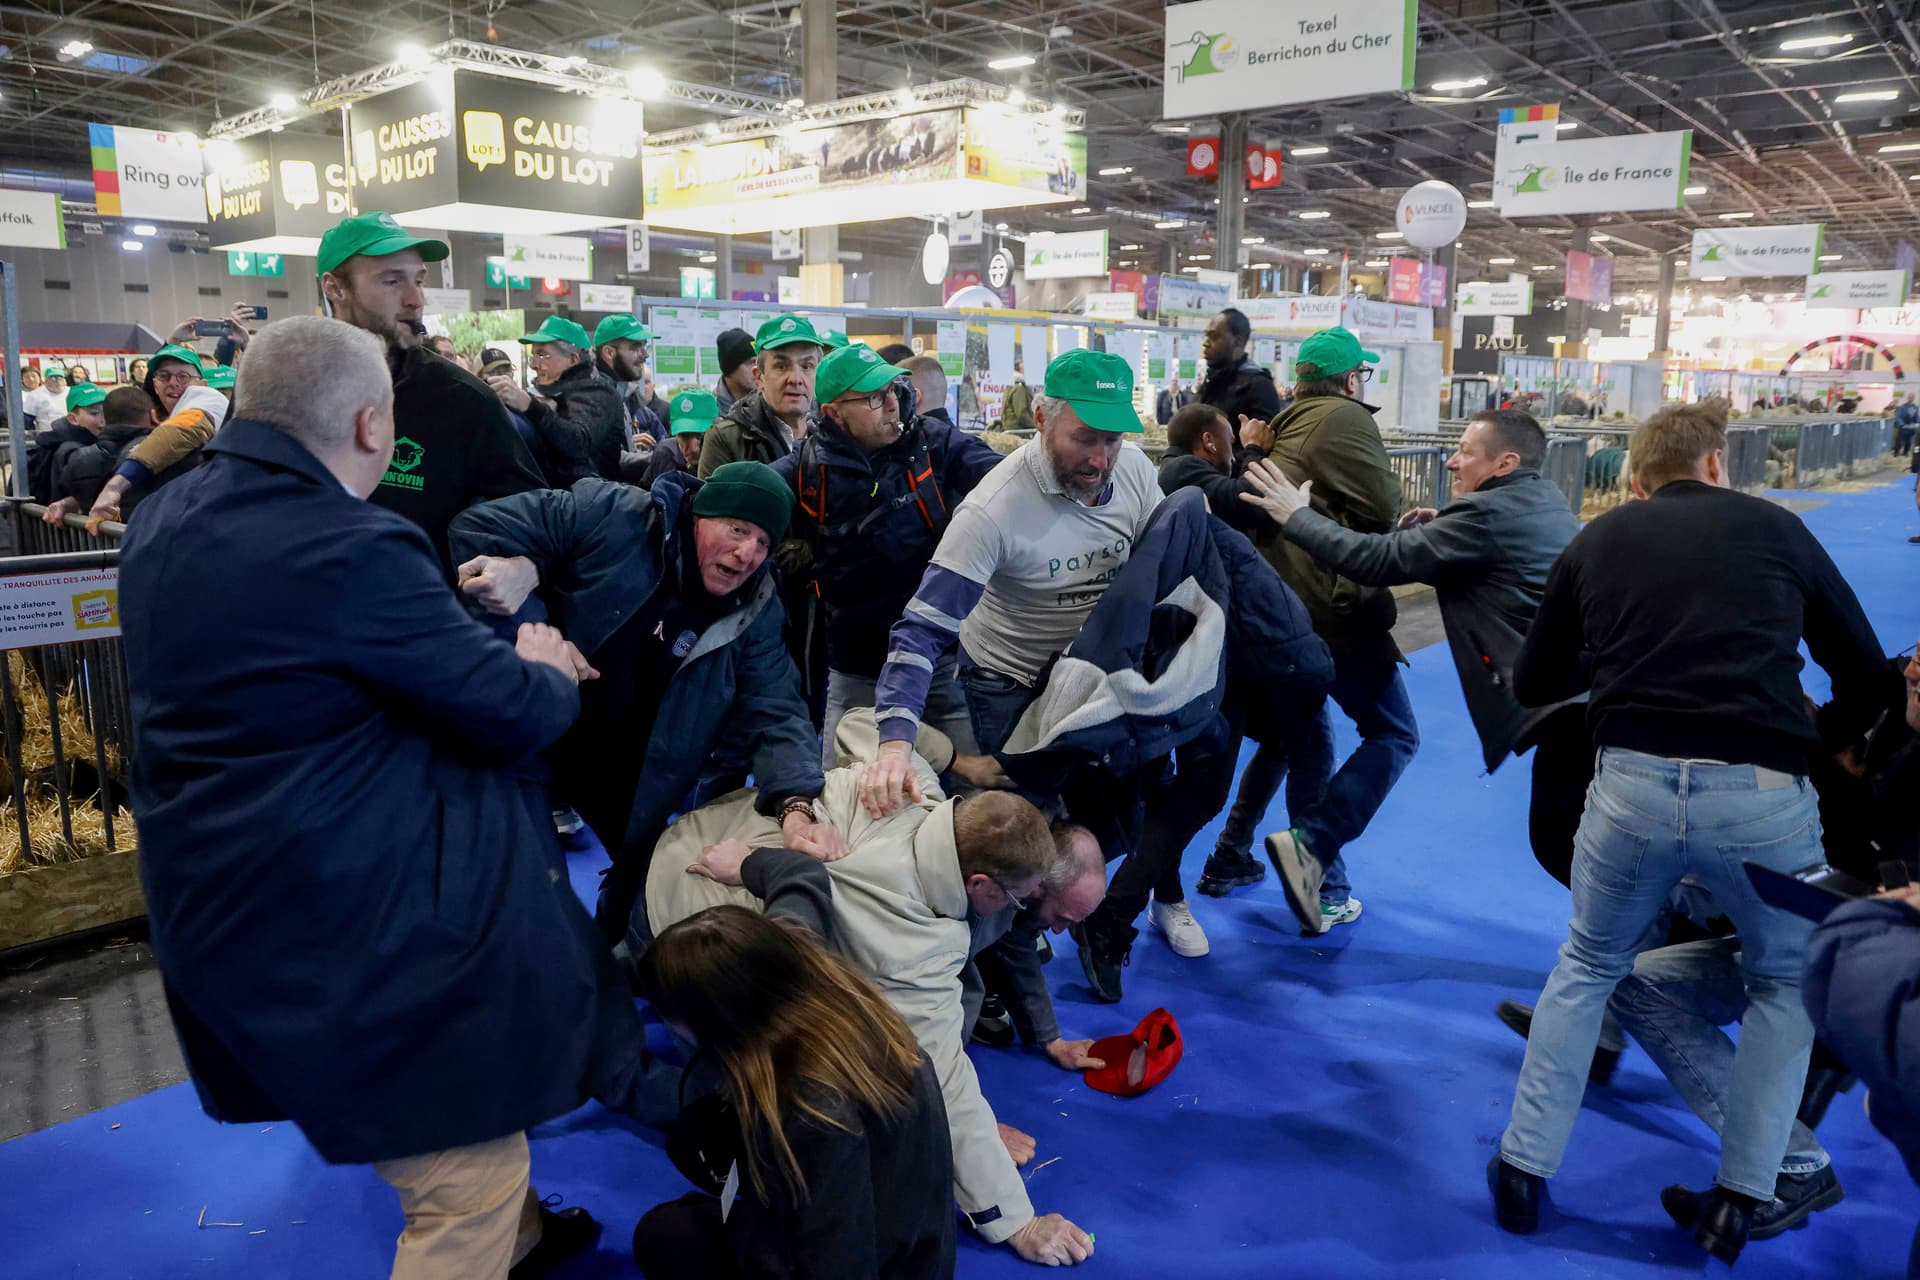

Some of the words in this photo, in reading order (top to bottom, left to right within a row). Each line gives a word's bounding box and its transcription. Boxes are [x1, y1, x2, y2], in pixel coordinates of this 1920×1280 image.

[1298, 15, 1337, 35] Texel
[1247, 41, 1322, 66] Berrichon
[1326, 38, 1347, 55] du
[1351, 33, 1393, 50] Cher
[514, 117, 638, 160] CAUSS
[472, 144, 494, 157] LOT
[380, 157, 403, 185] DU
[405, 147, 437, 179] LOT
[514, 150, 555, 180] DU
[561, 156, 615, 187] LOT
[1564, 166, 1584, 184] Île
[1588, 168, 1609, 182] de
[1614, 167, 1673, 181] France
[124, 164, 170, 190] Ring
[222, 196, 239, 219] DU
[239, 189, 262, 216] LOT
[0, 211, 33, 225] ffolk
[632, 229, 643, 252] B
[559, 252, 585, 263] France
[1752, 245, 1766, 256] de
[1770, 245, 1811, 256] France
[1300, 302, 1337, 313] VENDÉE
[1474, 333, 1529, 351] PAUL
[63, 576, 80, 585] DES
[80, 573, 119, 584] ANIMAUX
[21, 600, 57, 610] distance
[4, 613, 16, 621] les
[17, 611, 46, 620] touche
[47, 610, 63, 621] pas
[5, 624, 17, 632] les
[18, 621, 48, 632] nourris
[50, 620, 65, 631] pas
